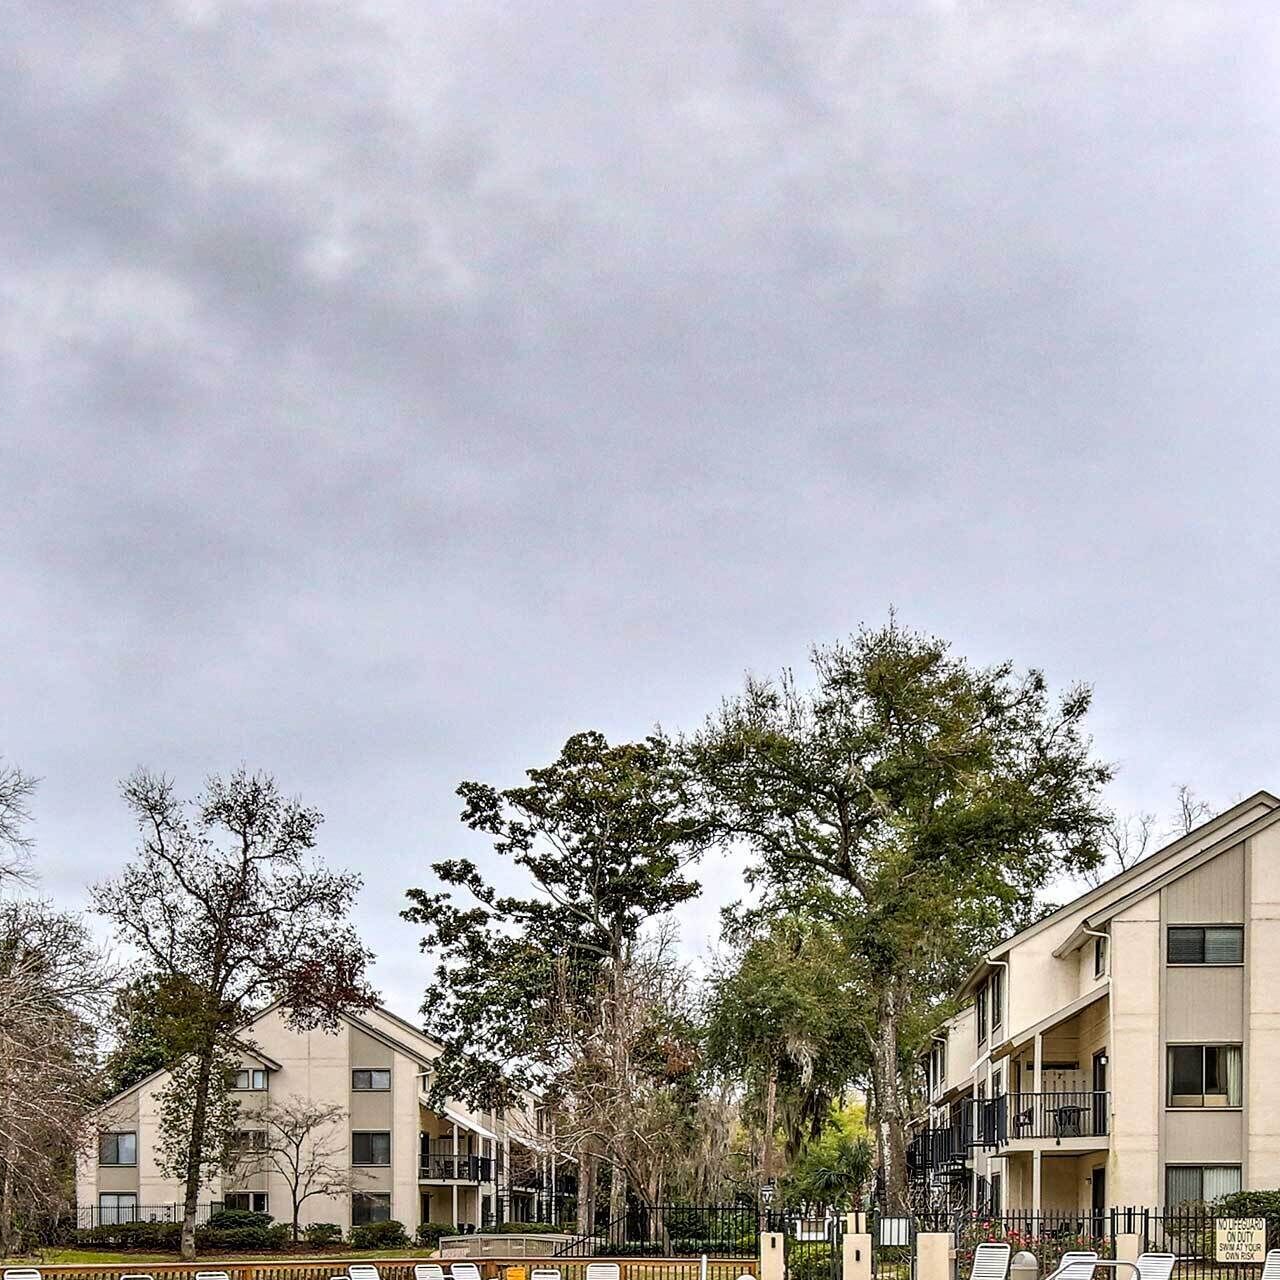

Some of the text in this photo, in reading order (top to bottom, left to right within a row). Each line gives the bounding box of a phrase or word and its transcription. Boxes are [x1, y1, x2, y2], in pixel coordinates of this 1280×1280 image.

[1218, 1218, 1264, 1230] NO LIFEGUARD
[1227, 1231, 1254, 1242] ON DUTY
[1220, 1243, 1262, 1251] SWIM AT YOUR
[1225, 1252, 1255, 1260] OWN RISK
